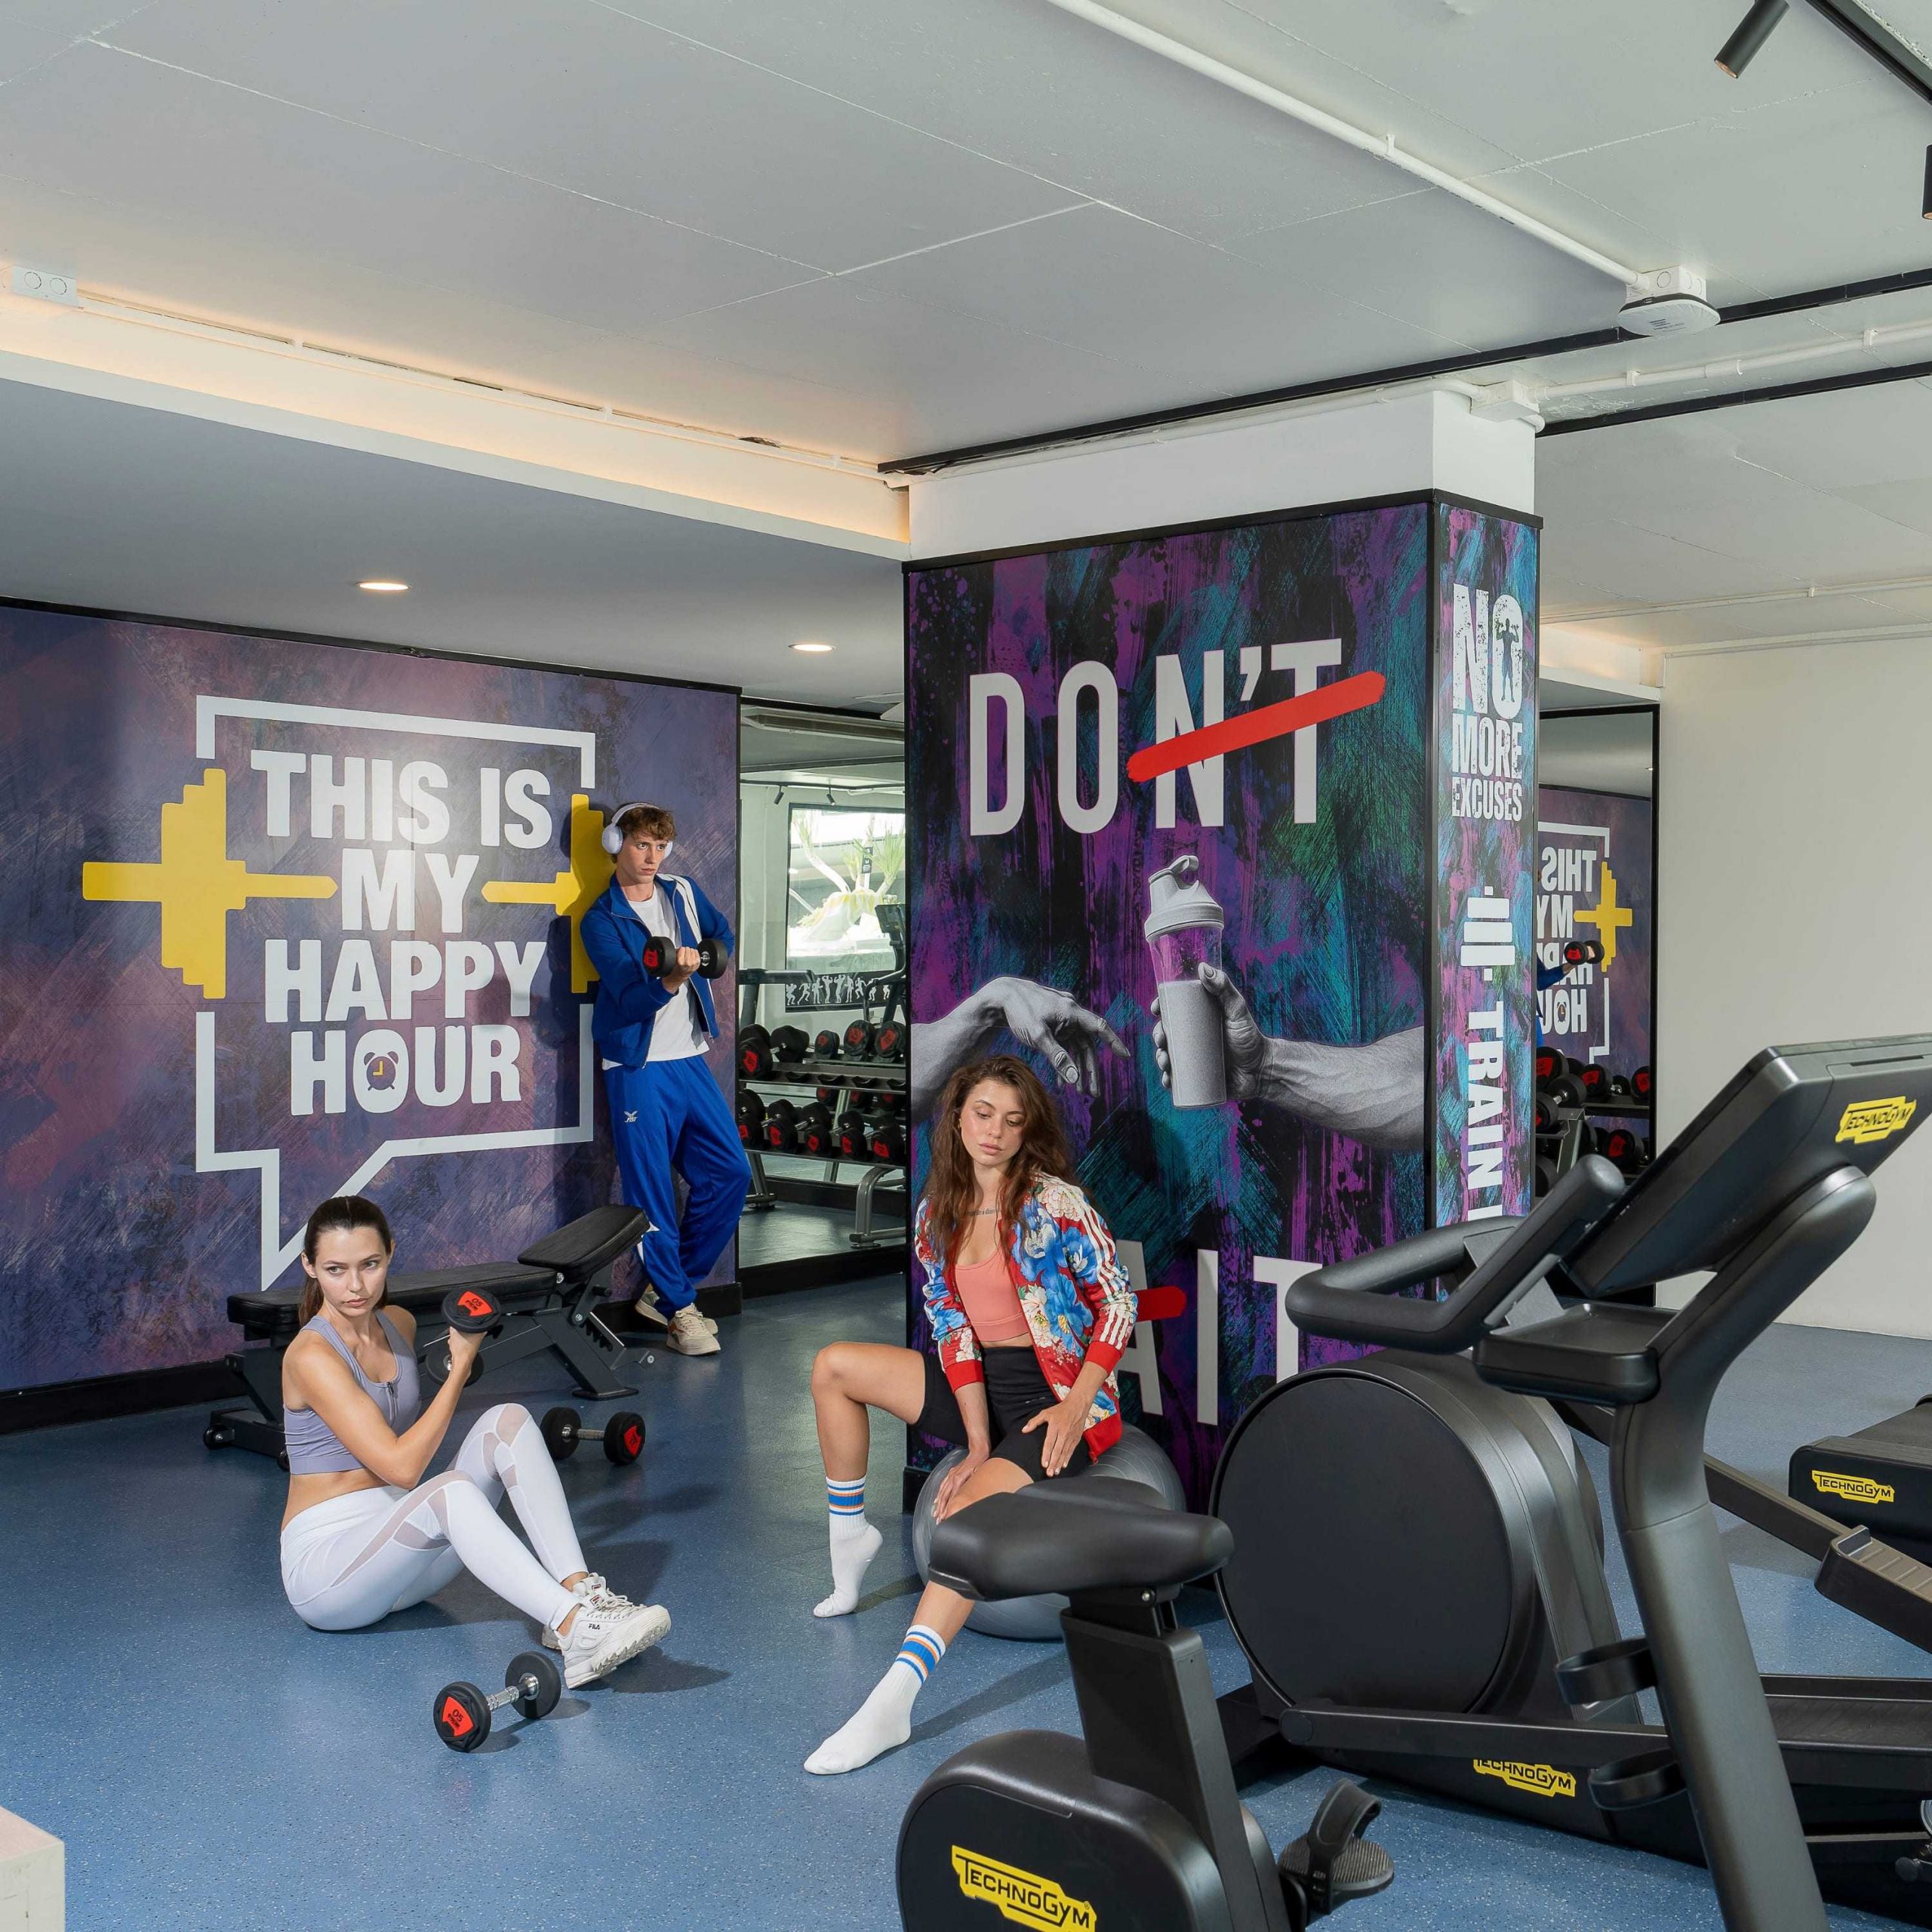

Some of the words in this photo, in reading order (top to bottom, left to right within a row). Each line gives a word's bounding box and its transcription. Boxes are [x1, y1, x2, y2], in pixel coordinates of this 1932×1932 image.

[1452, 583, 1524, 719] NO
[969, 638, 1343, 836] DON’T
[1451, 716, 1524, 780] MORE
[250, 749, 450, 845] THIS
[480, 767, 552, 849] IS
[1451, 777, 1523, 823] EXCUSES
[341, 848, 479, 934] MY
[265, 939, 547, 1023] HAPPY
[291, 1024, 522, 1116] HOUR
[1468, 1000, 1504, 1190] TRAIN
[1115, 1239, 1323, 1426] AIT
[1814, 1473, 1891, 1499] TECHNOGYM
[955, 1854, 1090, 1928] TECHNOGYM
